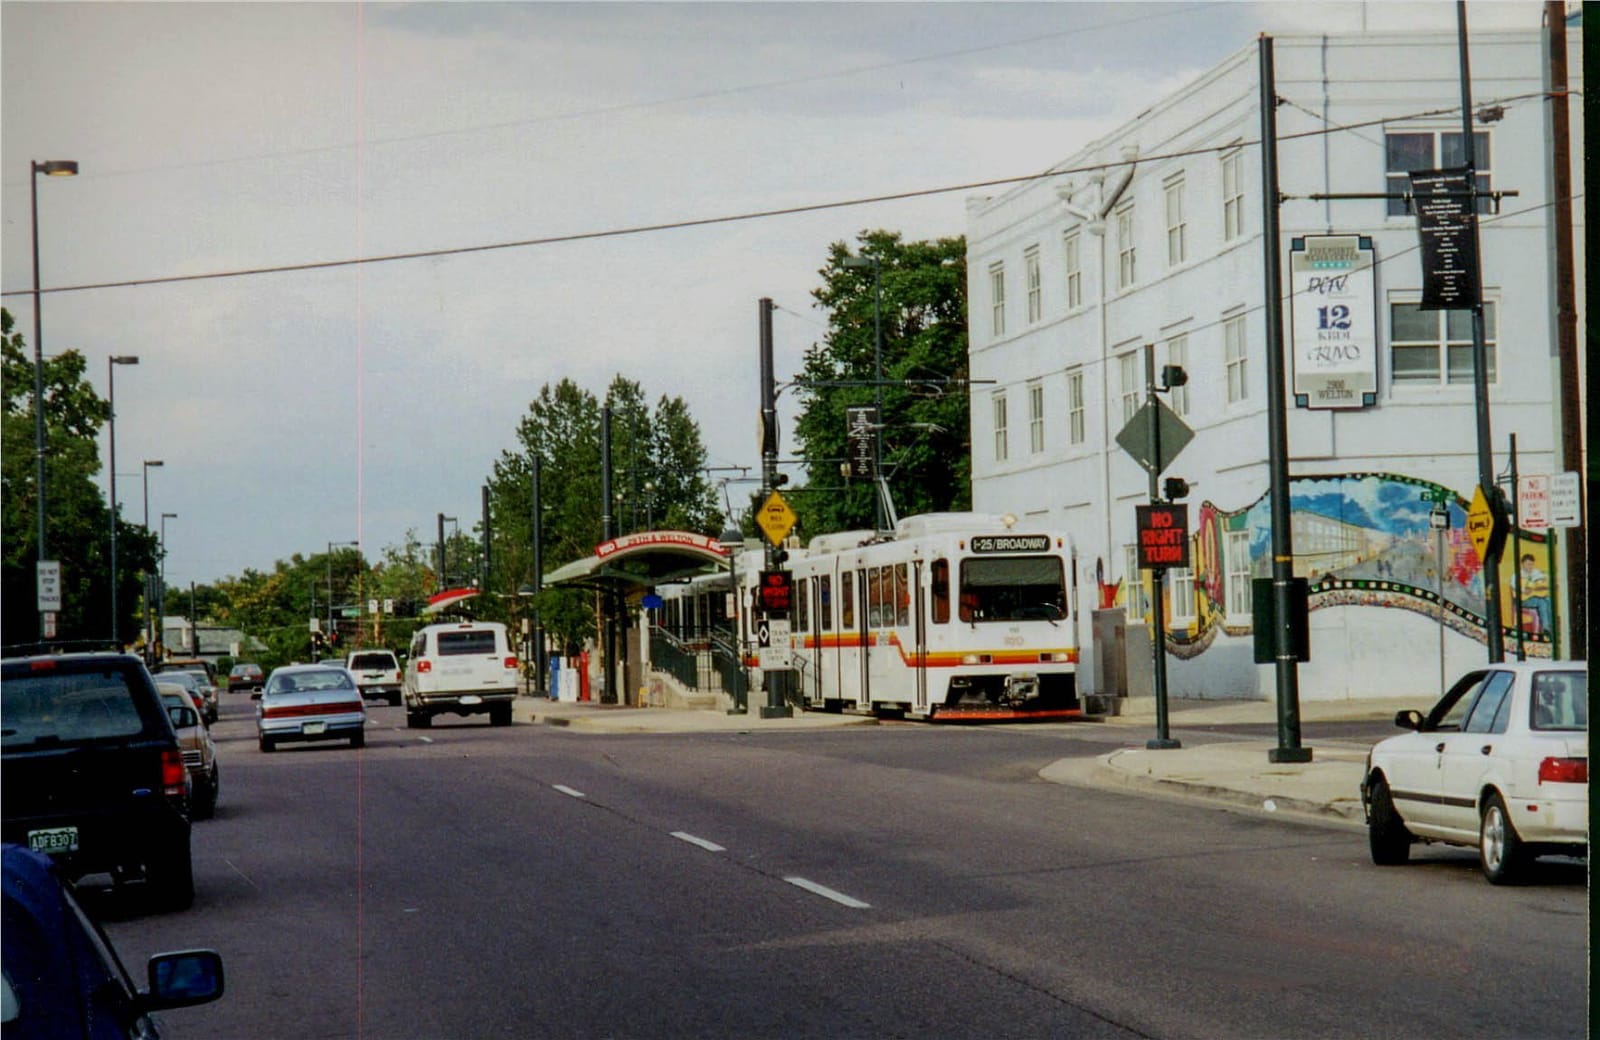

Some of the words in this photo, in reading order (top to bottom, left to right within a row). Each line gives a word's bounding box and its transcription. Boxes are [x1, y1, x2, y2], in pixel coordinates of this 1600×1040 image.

[1317, 304, 1352, 329] 12
[1318, 389, 1353, 399] WELTON
[1151, 512, 1172, 528] NO
[1142, 528, 1183, 545] RIGHT
[1145, 546, 1182, 562] TURN
